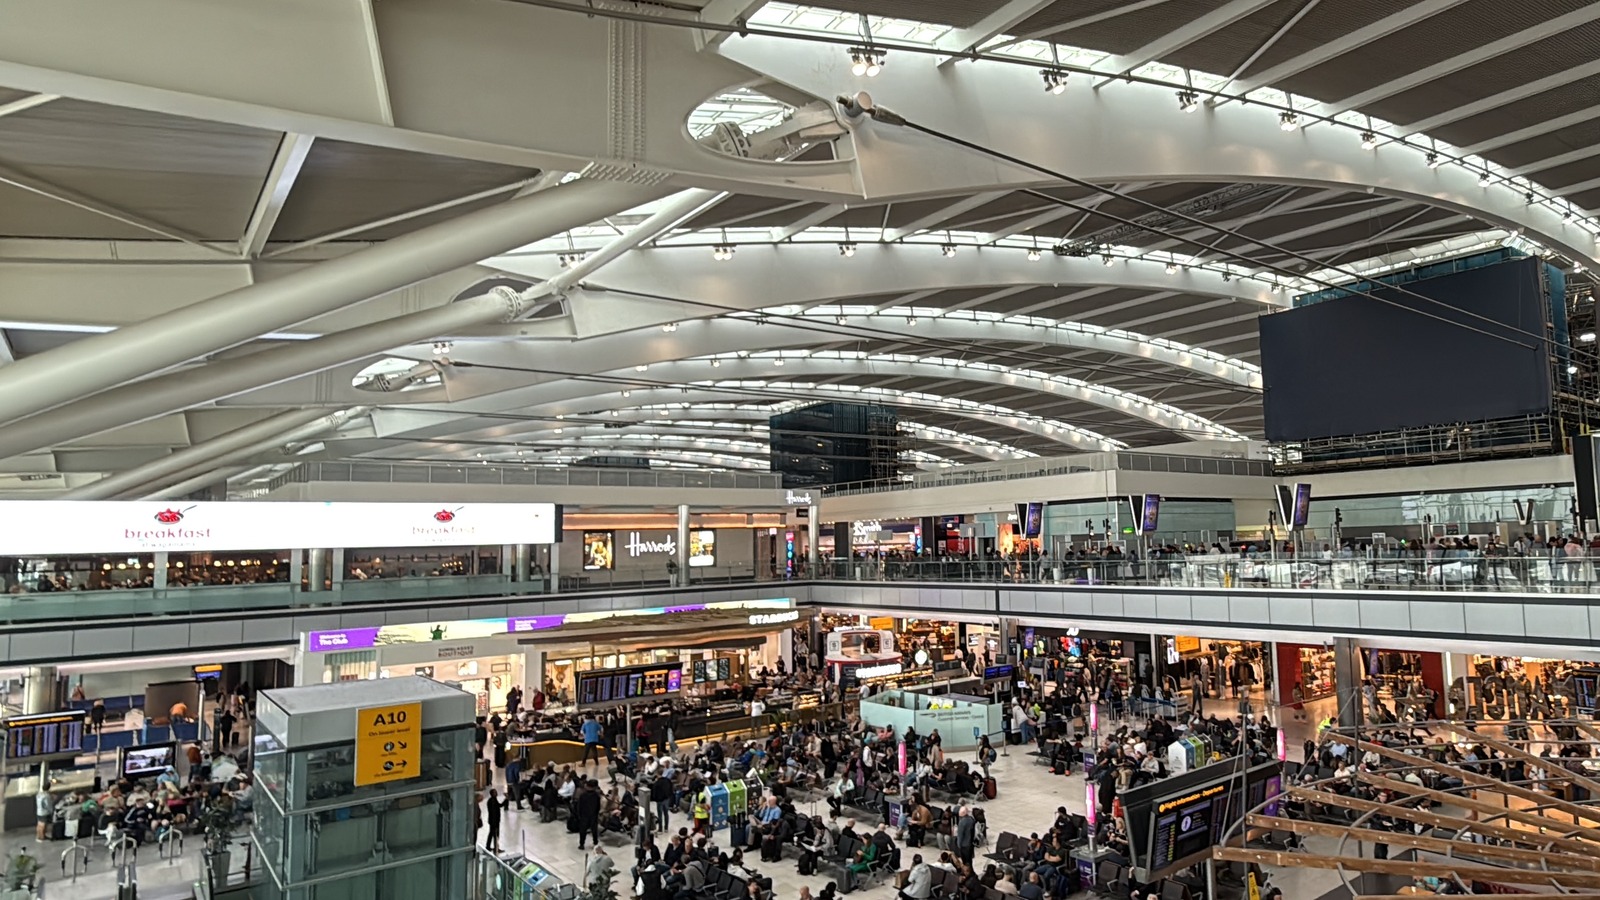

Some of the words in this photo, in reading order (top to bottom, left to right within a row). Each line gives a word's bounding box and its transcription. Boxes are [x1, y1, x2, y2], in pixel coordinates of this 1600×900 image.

[785, 490, 812, 505] Harrods
[125, 528, 211, 539] breakfast
[624, 531, 677, 556] Harrods
[438, 650, 474, 658] BOUTIQUE
[373, 711, 407, 726] A10
[1164, 801, 1176, 810] Flight
[1177, 793, 1201, 805] Information
[1203, 785, 1224, 797] Departures
